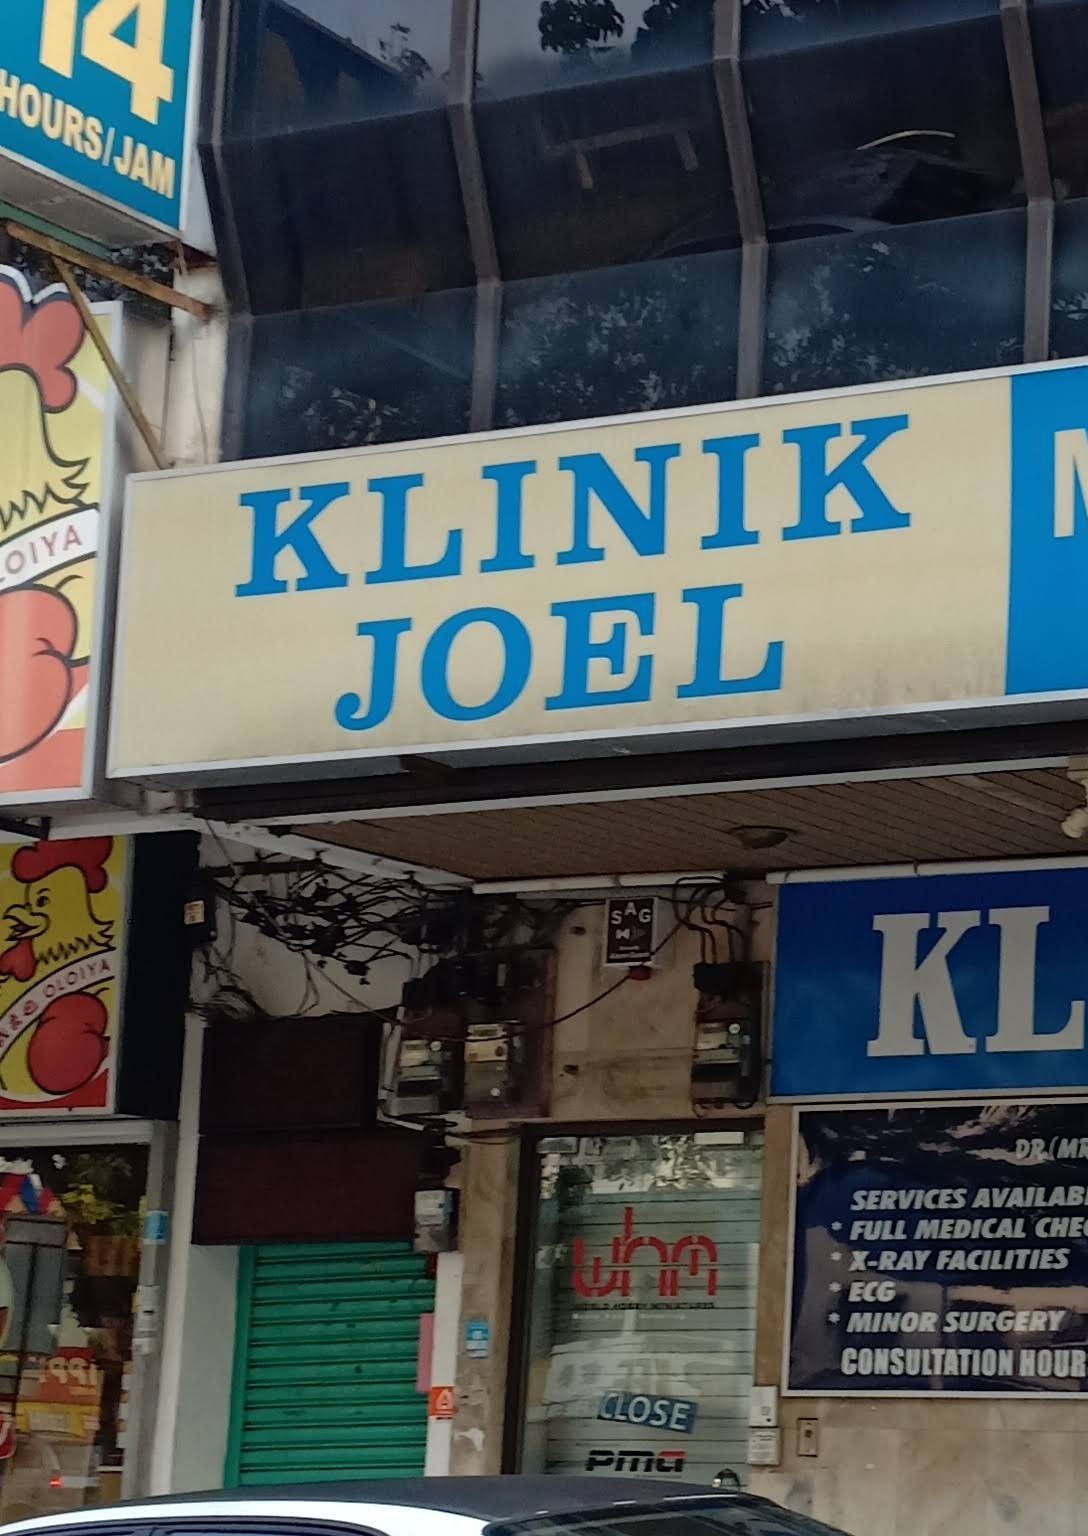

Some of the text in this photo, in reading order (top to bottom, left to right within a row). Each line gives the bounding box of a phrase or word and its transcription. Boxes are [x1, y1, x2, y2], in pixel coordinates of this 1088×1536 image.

[235, 414, 911, 597] KLINIK
[0, 524, 83, 582] OIYA
[334, 583, 785, 732] JOEL
[850, 1188, 968, 1211] SERVICES
[850, 1220, 908, 1241] FULL
[914, 1218, 1026, 1240] MEDICAL
[848, 1248, 1071, 1272] X-RAY FACILITIES
[848, 1281, 897, 1303] ECG
[846, 1310, 1067, 1333] MINOR SURGERY
[840, 1348, 1014, 1377] CONSULTATION
[600, 1391, 691, 1431] CLOSE
